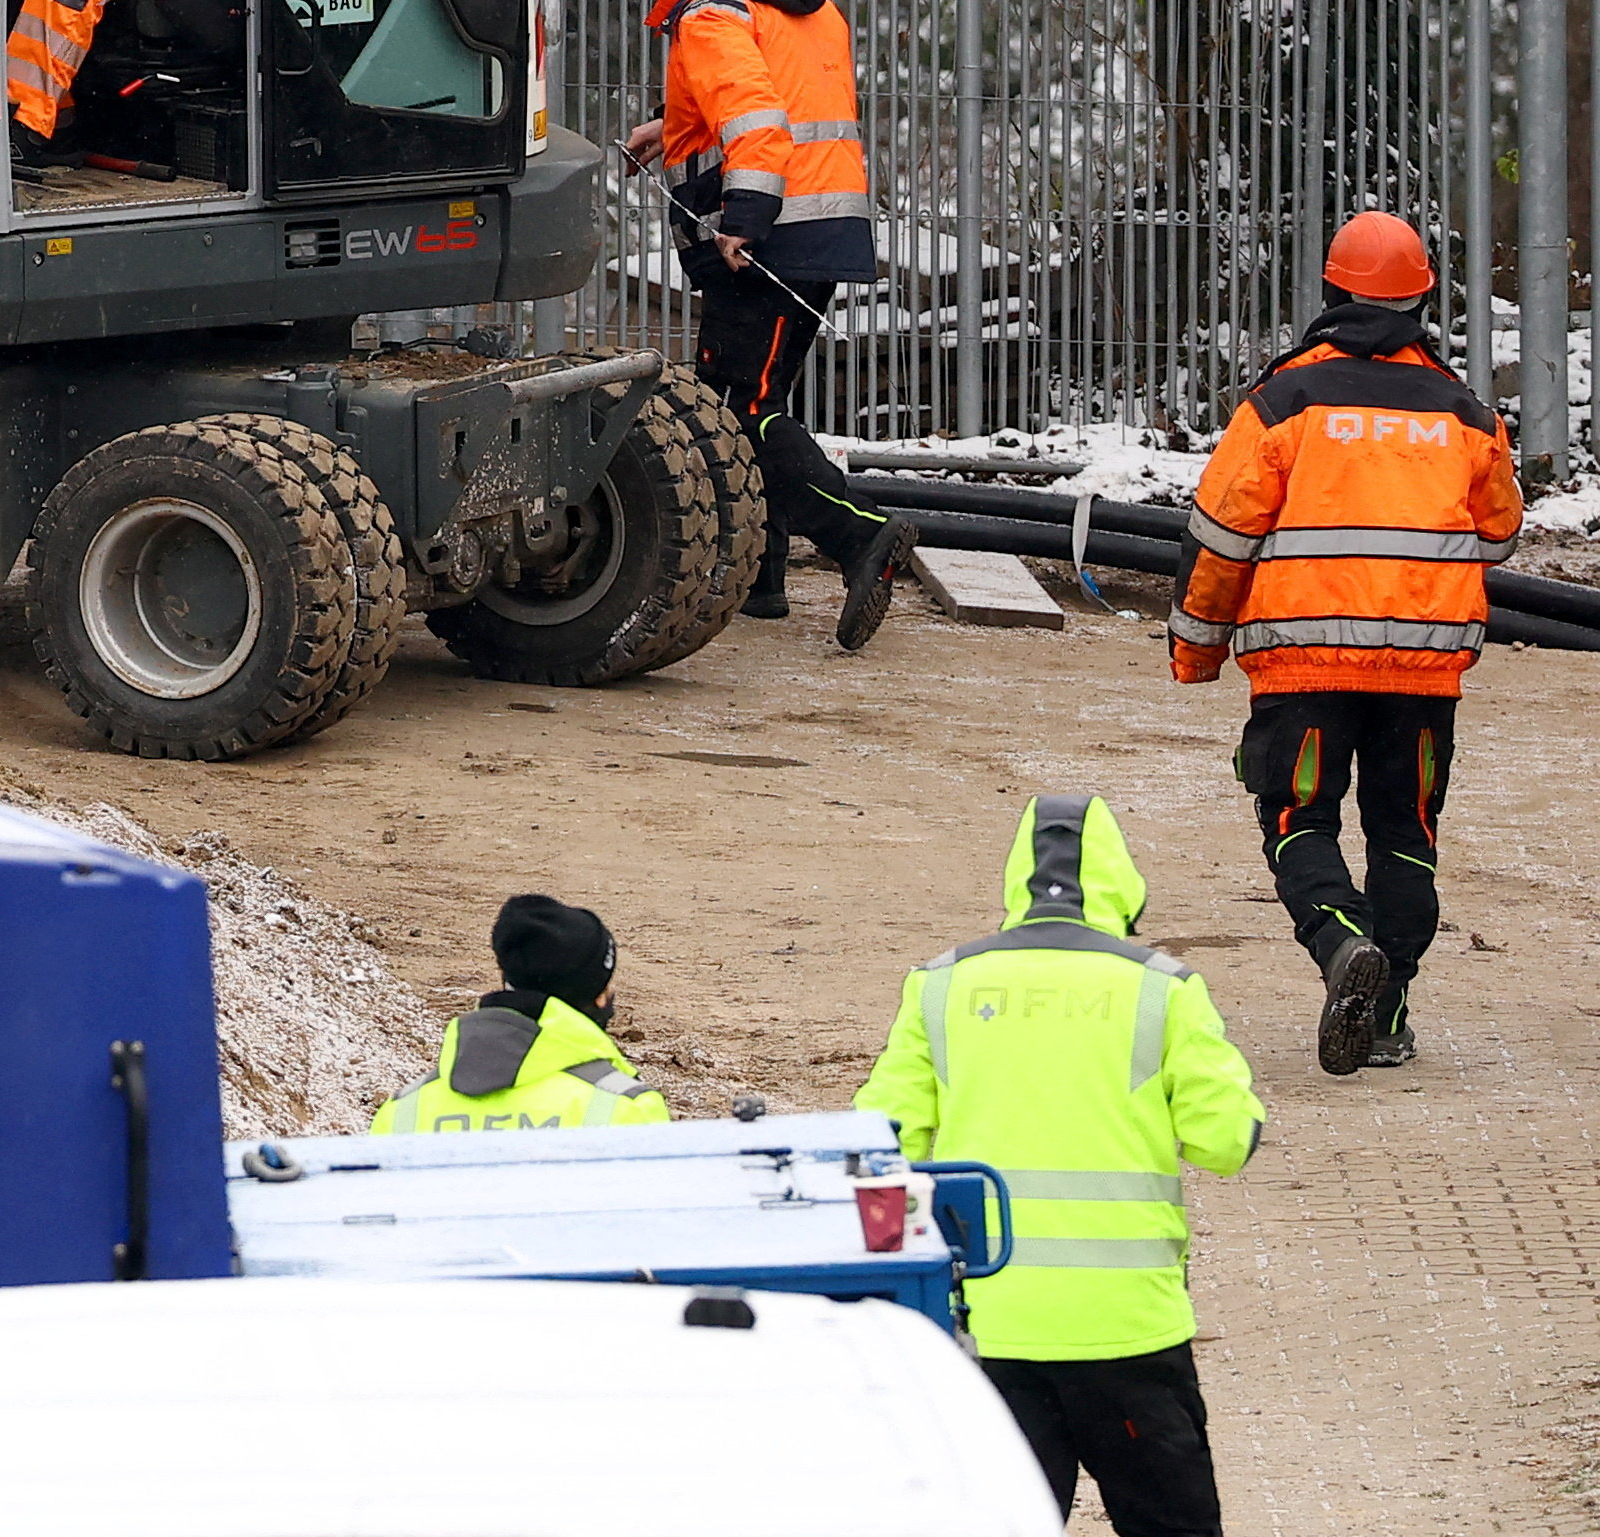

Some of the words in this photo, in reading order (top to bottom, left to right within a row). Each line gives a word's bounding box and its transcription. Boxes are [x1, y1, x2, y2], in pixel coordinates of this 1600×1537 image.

[345, 220, 479, 260] EW65
[1326, 412, 1449, 448] QFM
[968, 986, 1112, 1022] QFM
